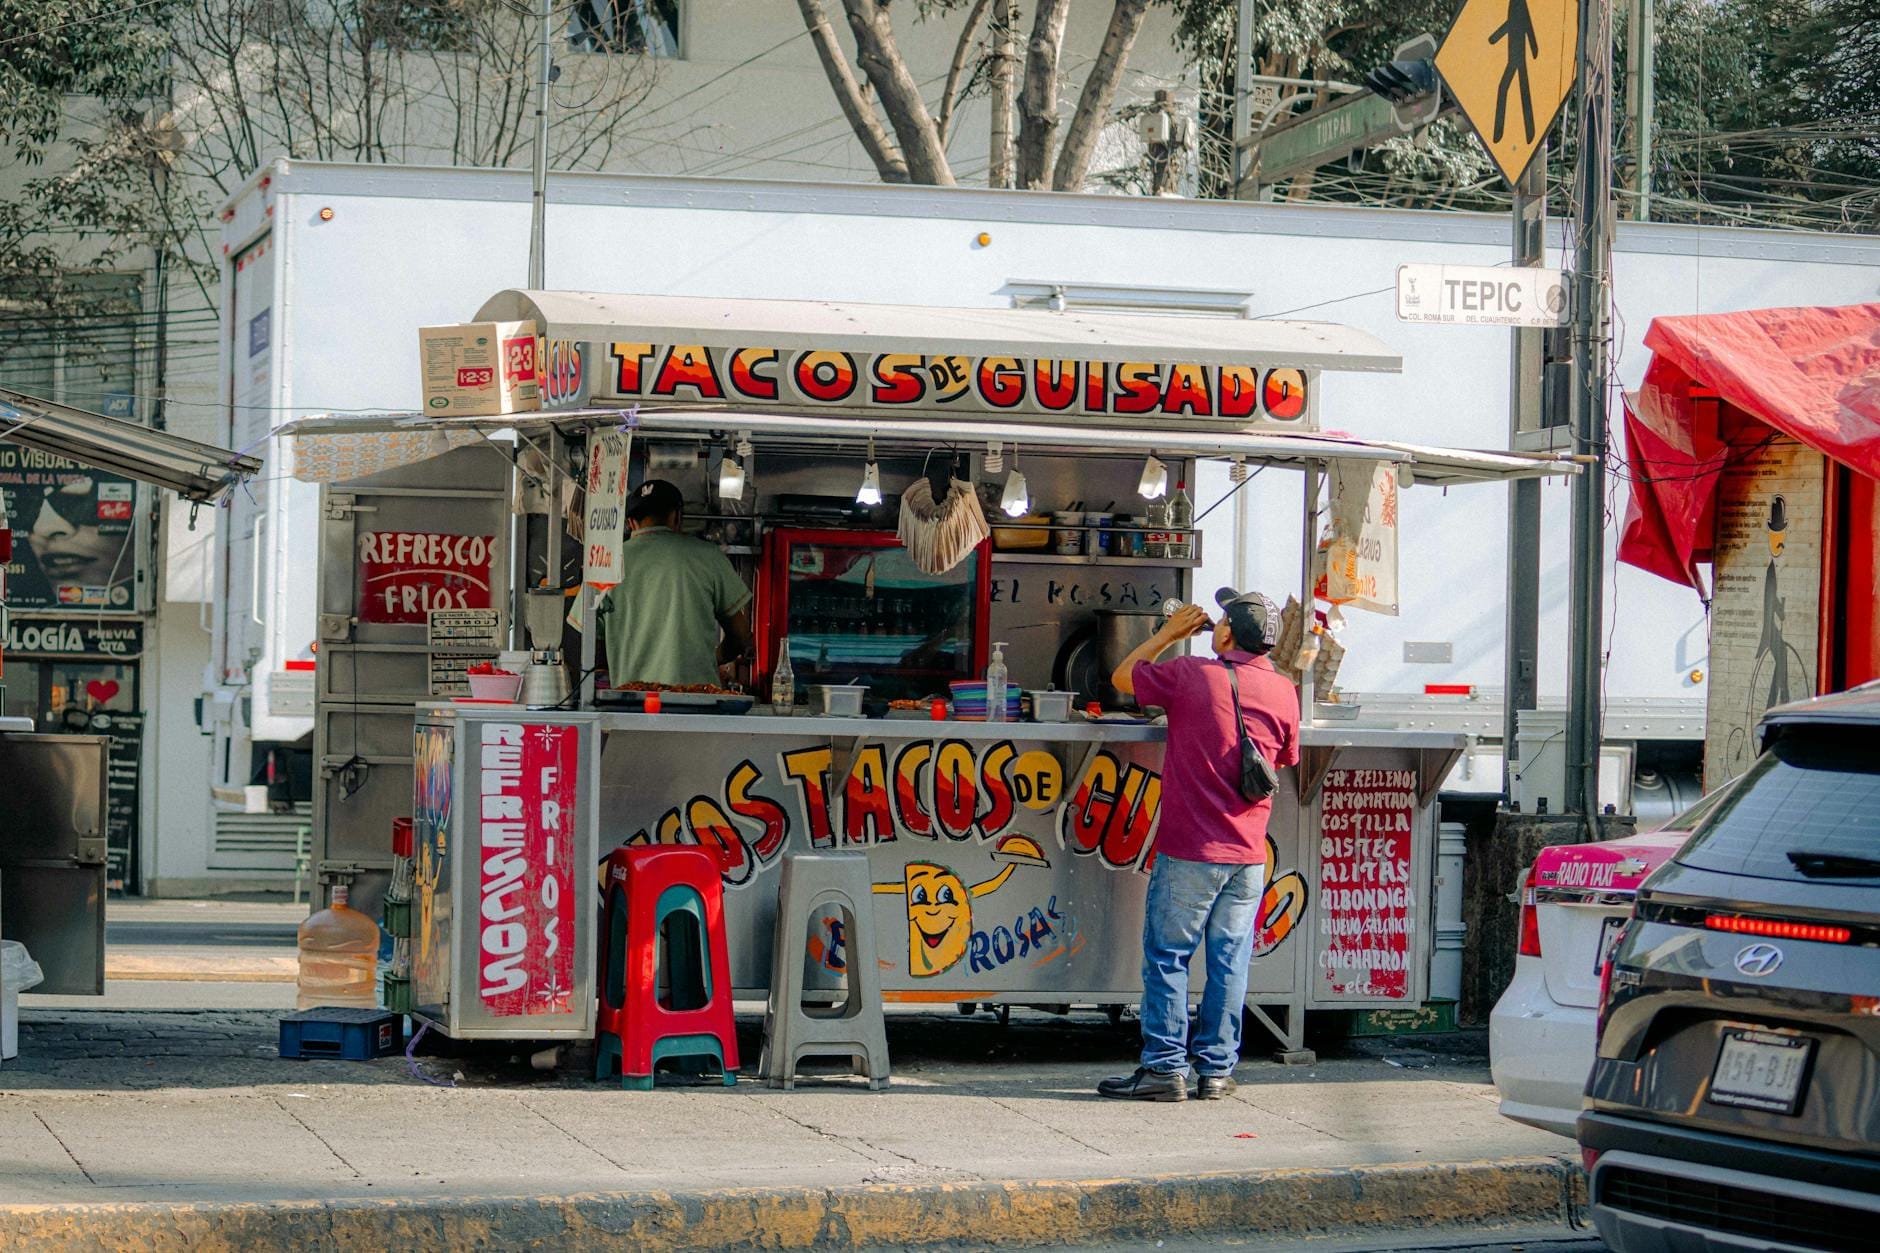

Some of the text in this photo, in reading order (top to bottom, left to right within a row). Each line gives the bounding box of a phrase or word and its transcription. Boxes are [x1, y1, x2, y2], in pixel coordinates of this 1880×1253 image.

[1317, 111, 1352, 145] TUXPAN
[1445, 279, 1522, 312] TEPIC
[1423, 313, 1441, 321] ROMA
[1443, 313, 1455, 322] SUR
[610, 342, 1309, 420] TACOS DE GUISADO
[590, 506, 618, 530] GUISADO
[359, 531, 500, 568] REFRESCOS
[384, 583, 469, 614] FRIOS
[990, 579, 1163, 607] EL ROSAS
[88, 628, 137, 639] PREVIA
[98, 641, 127, 652] CITA
[1322, 769, 1417, 789] CH. RELLENOS
[783, 738, 1017, 849] TACOS
[1013, 770, 1053, 804] DE
[1322, 791, 1417, 811] ENTOMATADO
[1321, 813, 1411, 832] COSTILLA
[481, 722, 529, 997] REFRESCOS
[1321, 837, 1397, 858] BISTEC
[540, 766, 561, 958] FRIOS
[1321, 860, 1410, 883] ALITAS
[1556, 861, 1617, 887] RADIO TAXI
[1320, 887, 1416, 911] ALBONDIGA
[1318, 949, 1411, 971] CHICHARRON
